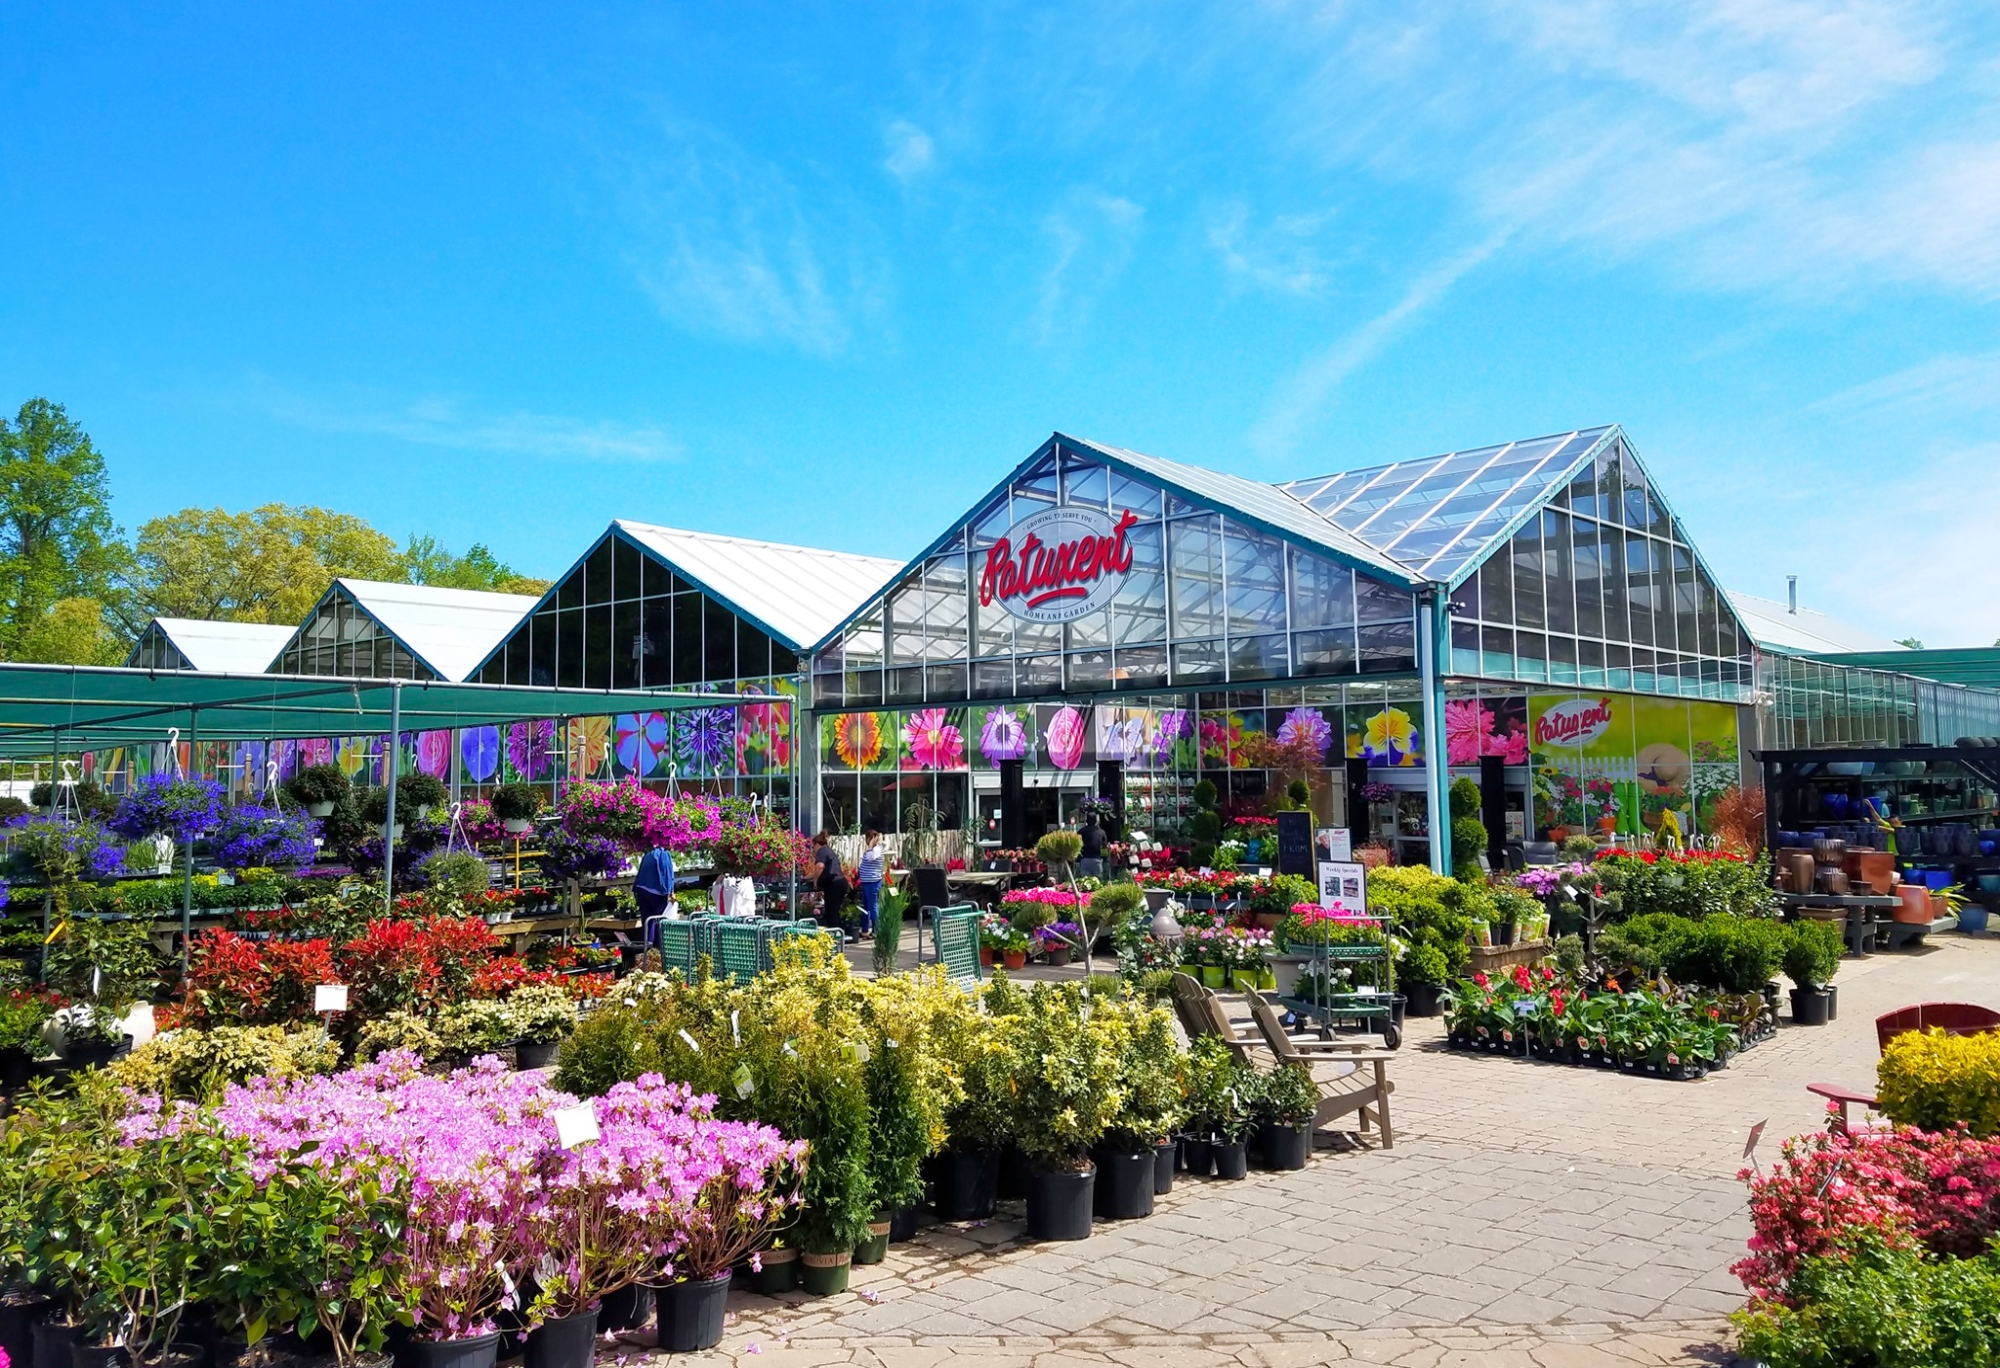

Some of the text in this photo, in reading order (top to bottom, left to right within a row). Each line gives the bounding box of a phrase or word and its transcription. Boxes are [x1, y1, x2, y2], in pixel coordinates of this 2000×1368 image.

[1026, 514, 1052, 530] GROWING
[1081, 514, 1093, 523] YOU
[980, 509, 1139, 607] Patuxent
[1023, 609, 1045, 620] HOME
[1063, 602, 1096, 618] GARDEN
